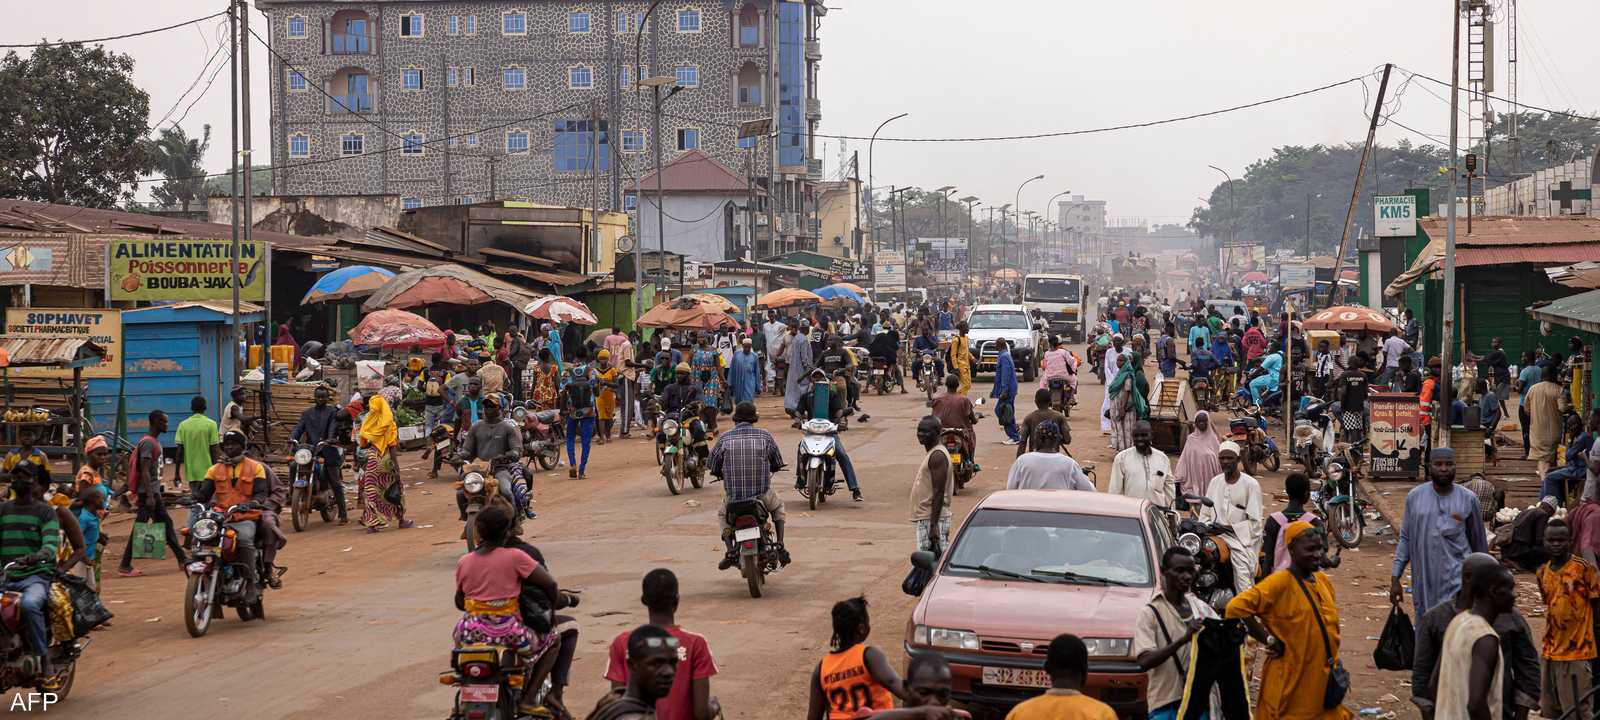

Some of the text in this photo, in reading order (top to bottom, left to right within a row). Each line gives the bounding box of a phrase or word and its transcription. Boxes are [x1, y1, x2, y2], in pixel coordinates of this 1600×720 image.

[1375, 197, 1415, 205] PHARMACIE
[1380, 205, 1410, 219] KM5
[27, 313, 103, 325] SOPHAVET
